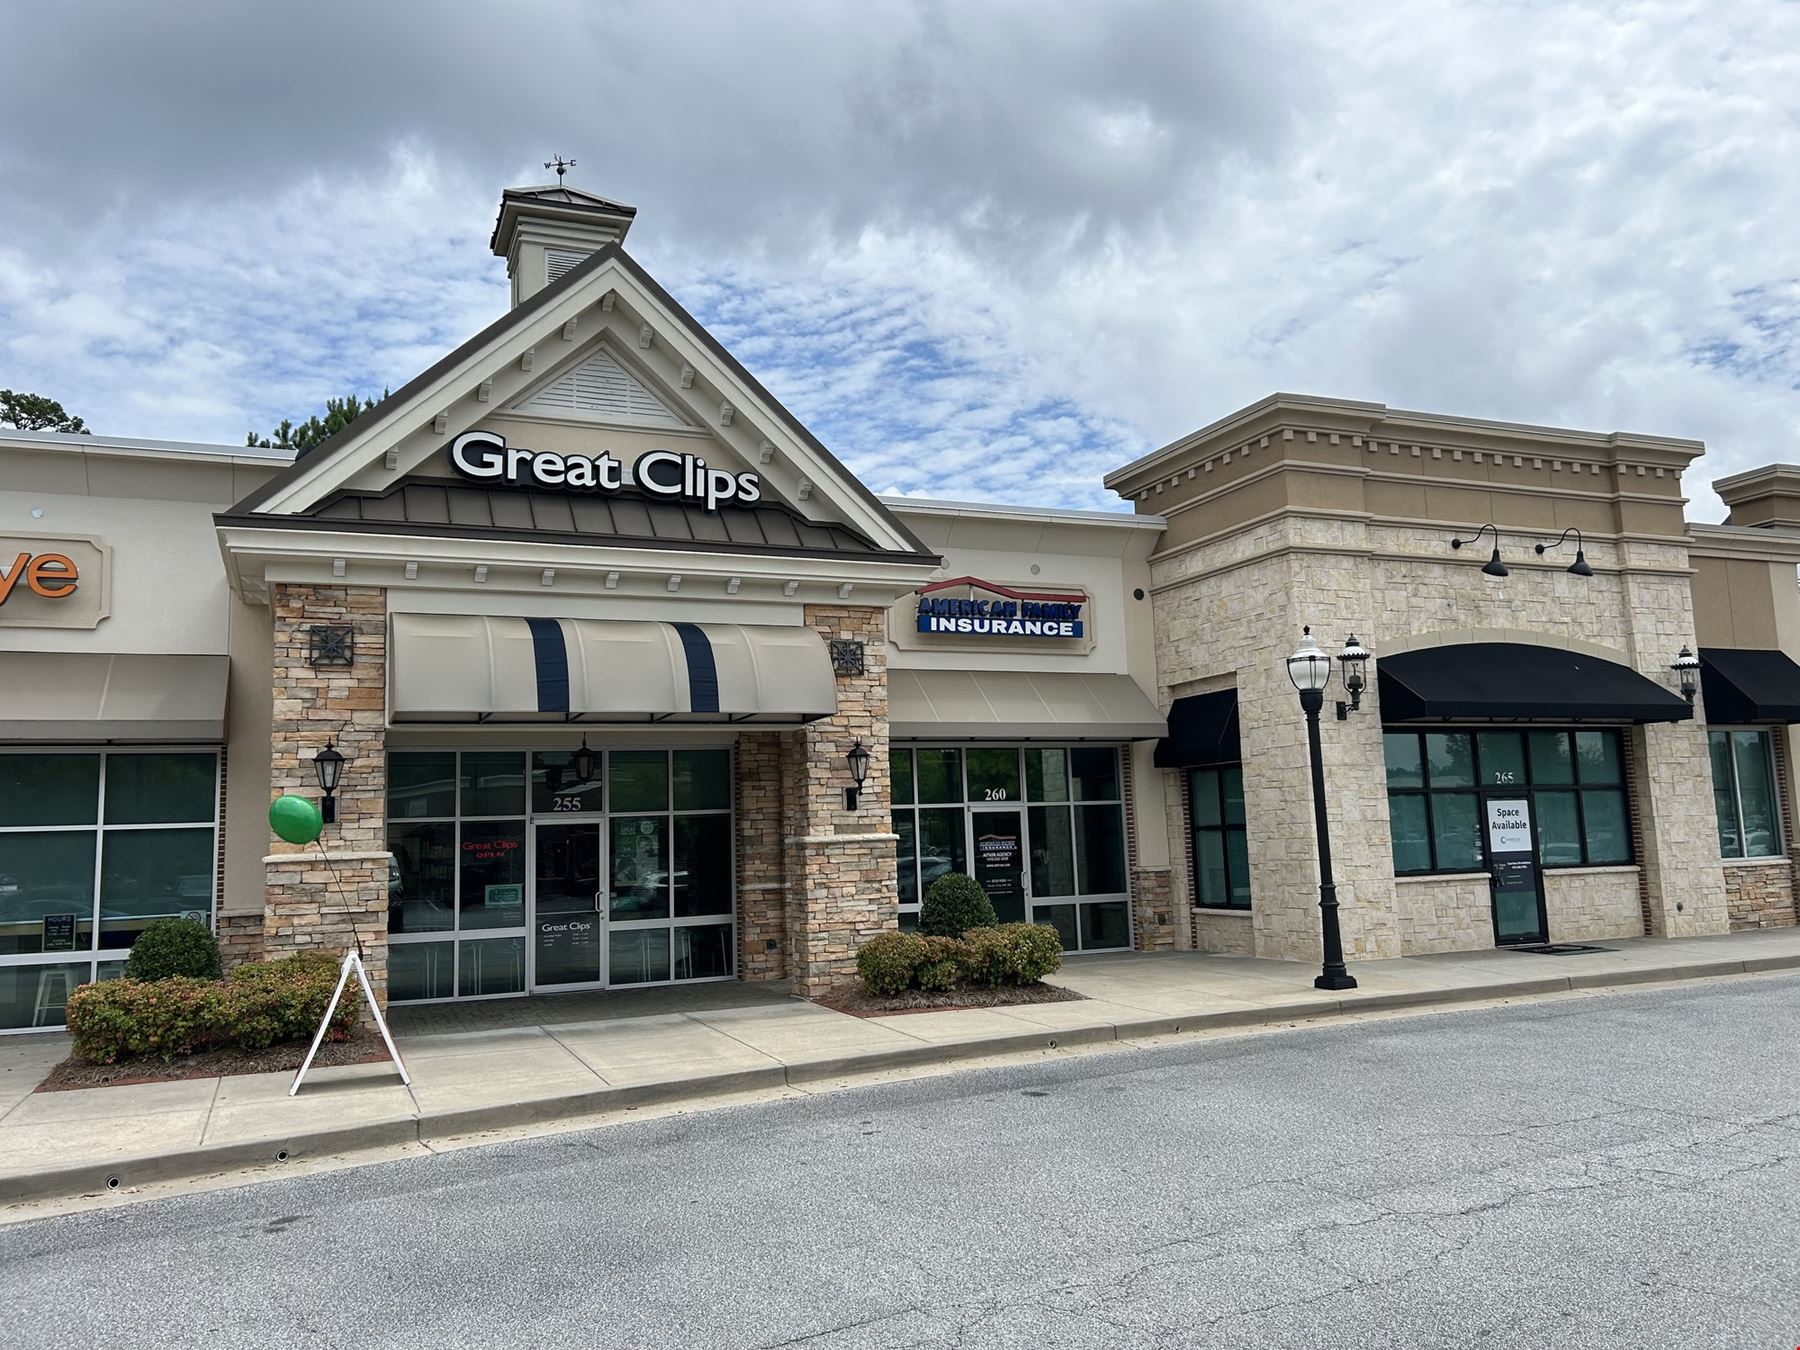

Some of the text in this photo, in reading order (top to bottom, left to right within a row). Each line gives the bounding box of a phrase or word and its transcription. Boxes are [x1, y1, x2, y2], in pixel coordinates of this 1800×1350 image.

[450, 430, 761, 511] Great Clips
[917, 597, 1083, 619] AMERICAN FAMILY
[930, 616, 1075, 637] INSURANCE
[1494, 771, 1515, 785] 265
[984, 787, 1007, 801] 260
[552, 796, 582, 811] 255
[1496, 807, 1520, 819] Space
[1491, 819, 1528, 830] Available
[462, 840, 519, 851] Great Clips
[476, 850, 506, 859] OPEN
[541, 921, 591, 932] Great Clips
